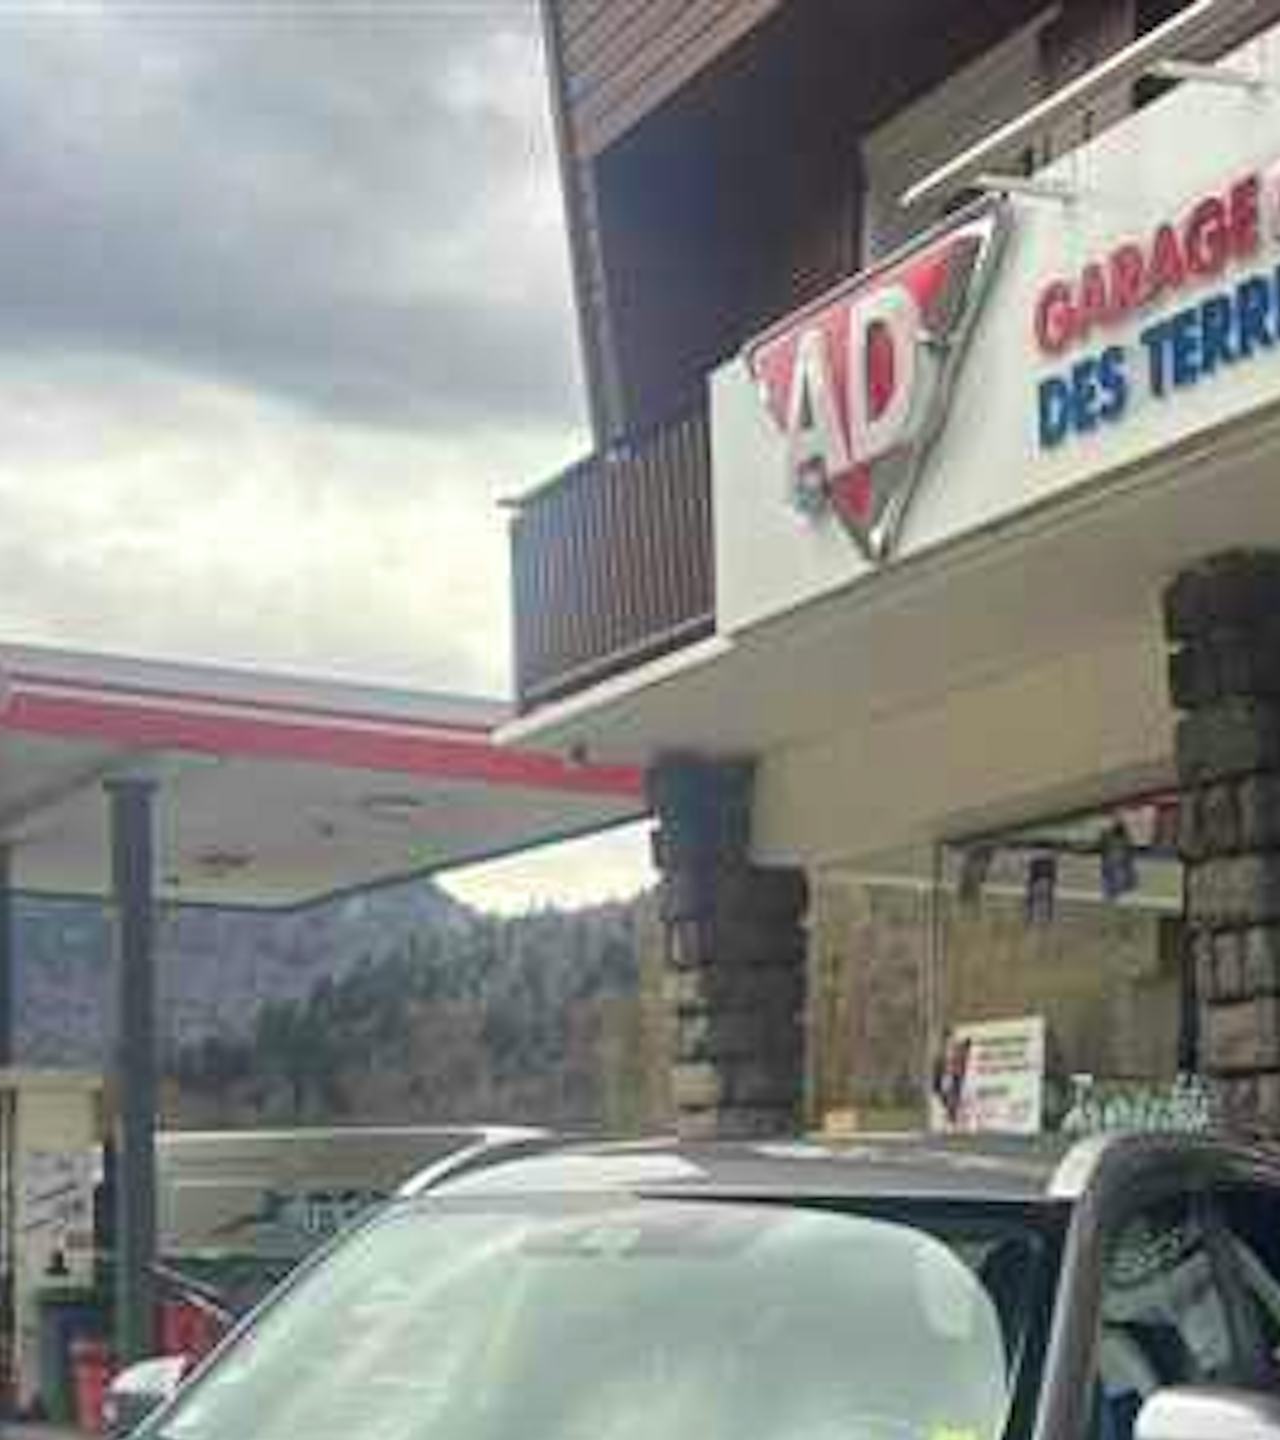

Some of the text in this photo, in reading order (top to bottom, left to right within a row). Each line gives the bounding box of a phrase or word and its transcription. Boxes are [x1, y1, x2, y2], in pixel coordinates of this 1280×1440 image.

[1035, 176, 1259, 356] GARAGE
[772, 284, 950, 490] AD
[1039, 349, 1127, 449] DES
